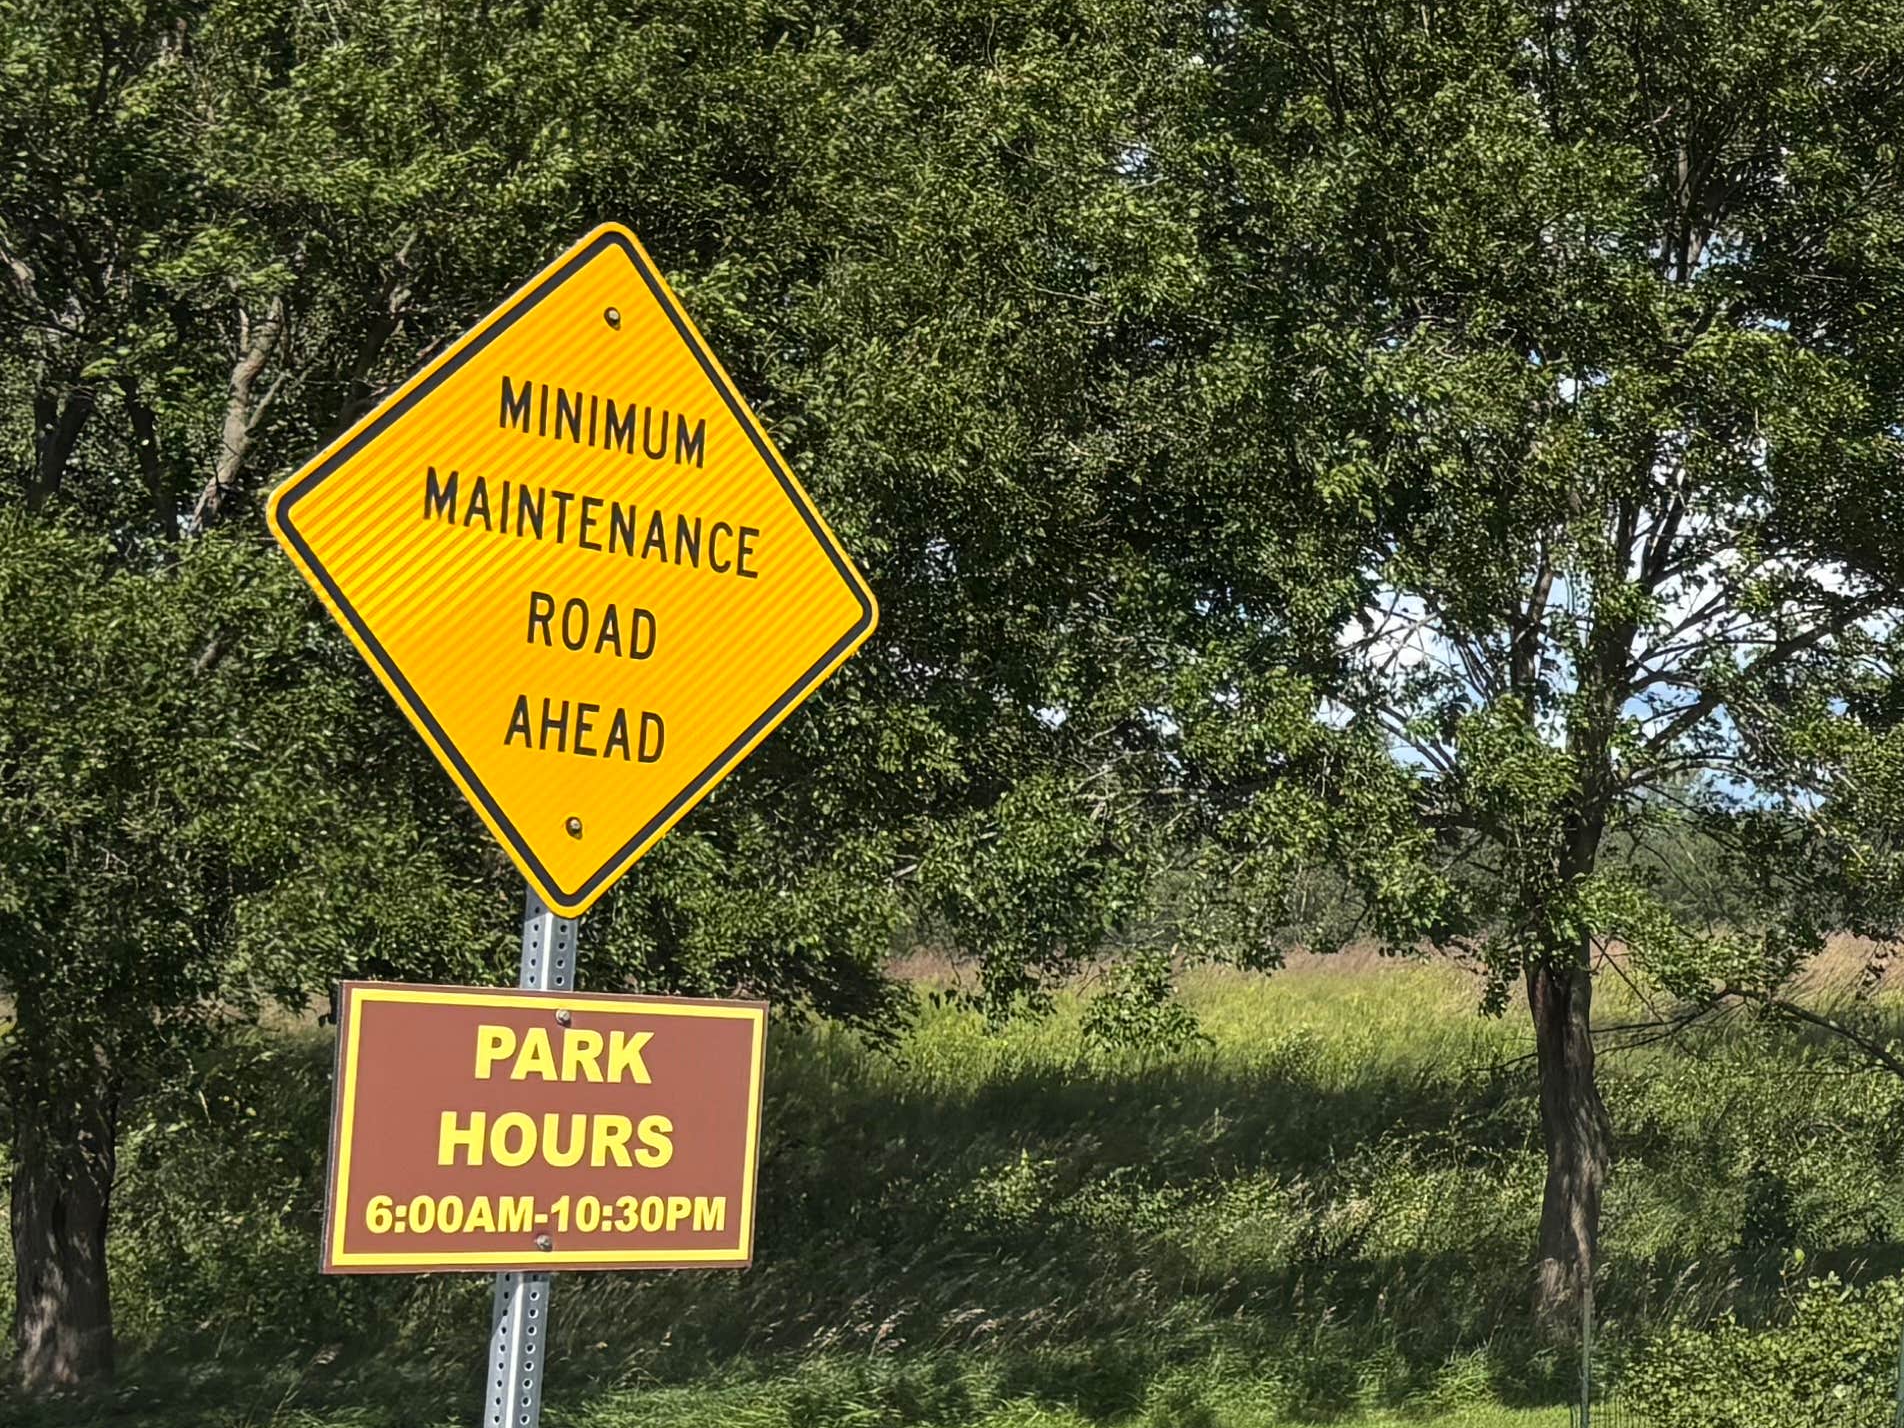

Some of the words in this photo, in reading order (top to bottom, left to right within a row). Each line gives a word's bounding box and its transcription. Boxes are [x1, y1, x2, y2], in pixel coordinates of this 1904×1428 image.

[499, 375, 706, 469] MINIMUM
[424, 466, 760, 579] MAINTENANCE
[527, 592, 657, 660] ROAD
[504, 694, 665, 764] AHEAD
[475, 1025, 654, 1084] PARK
[437, 1111, 674, 1169] HOURS
[365, 1194, 726, 1233] 6:00AM-10:30PM
